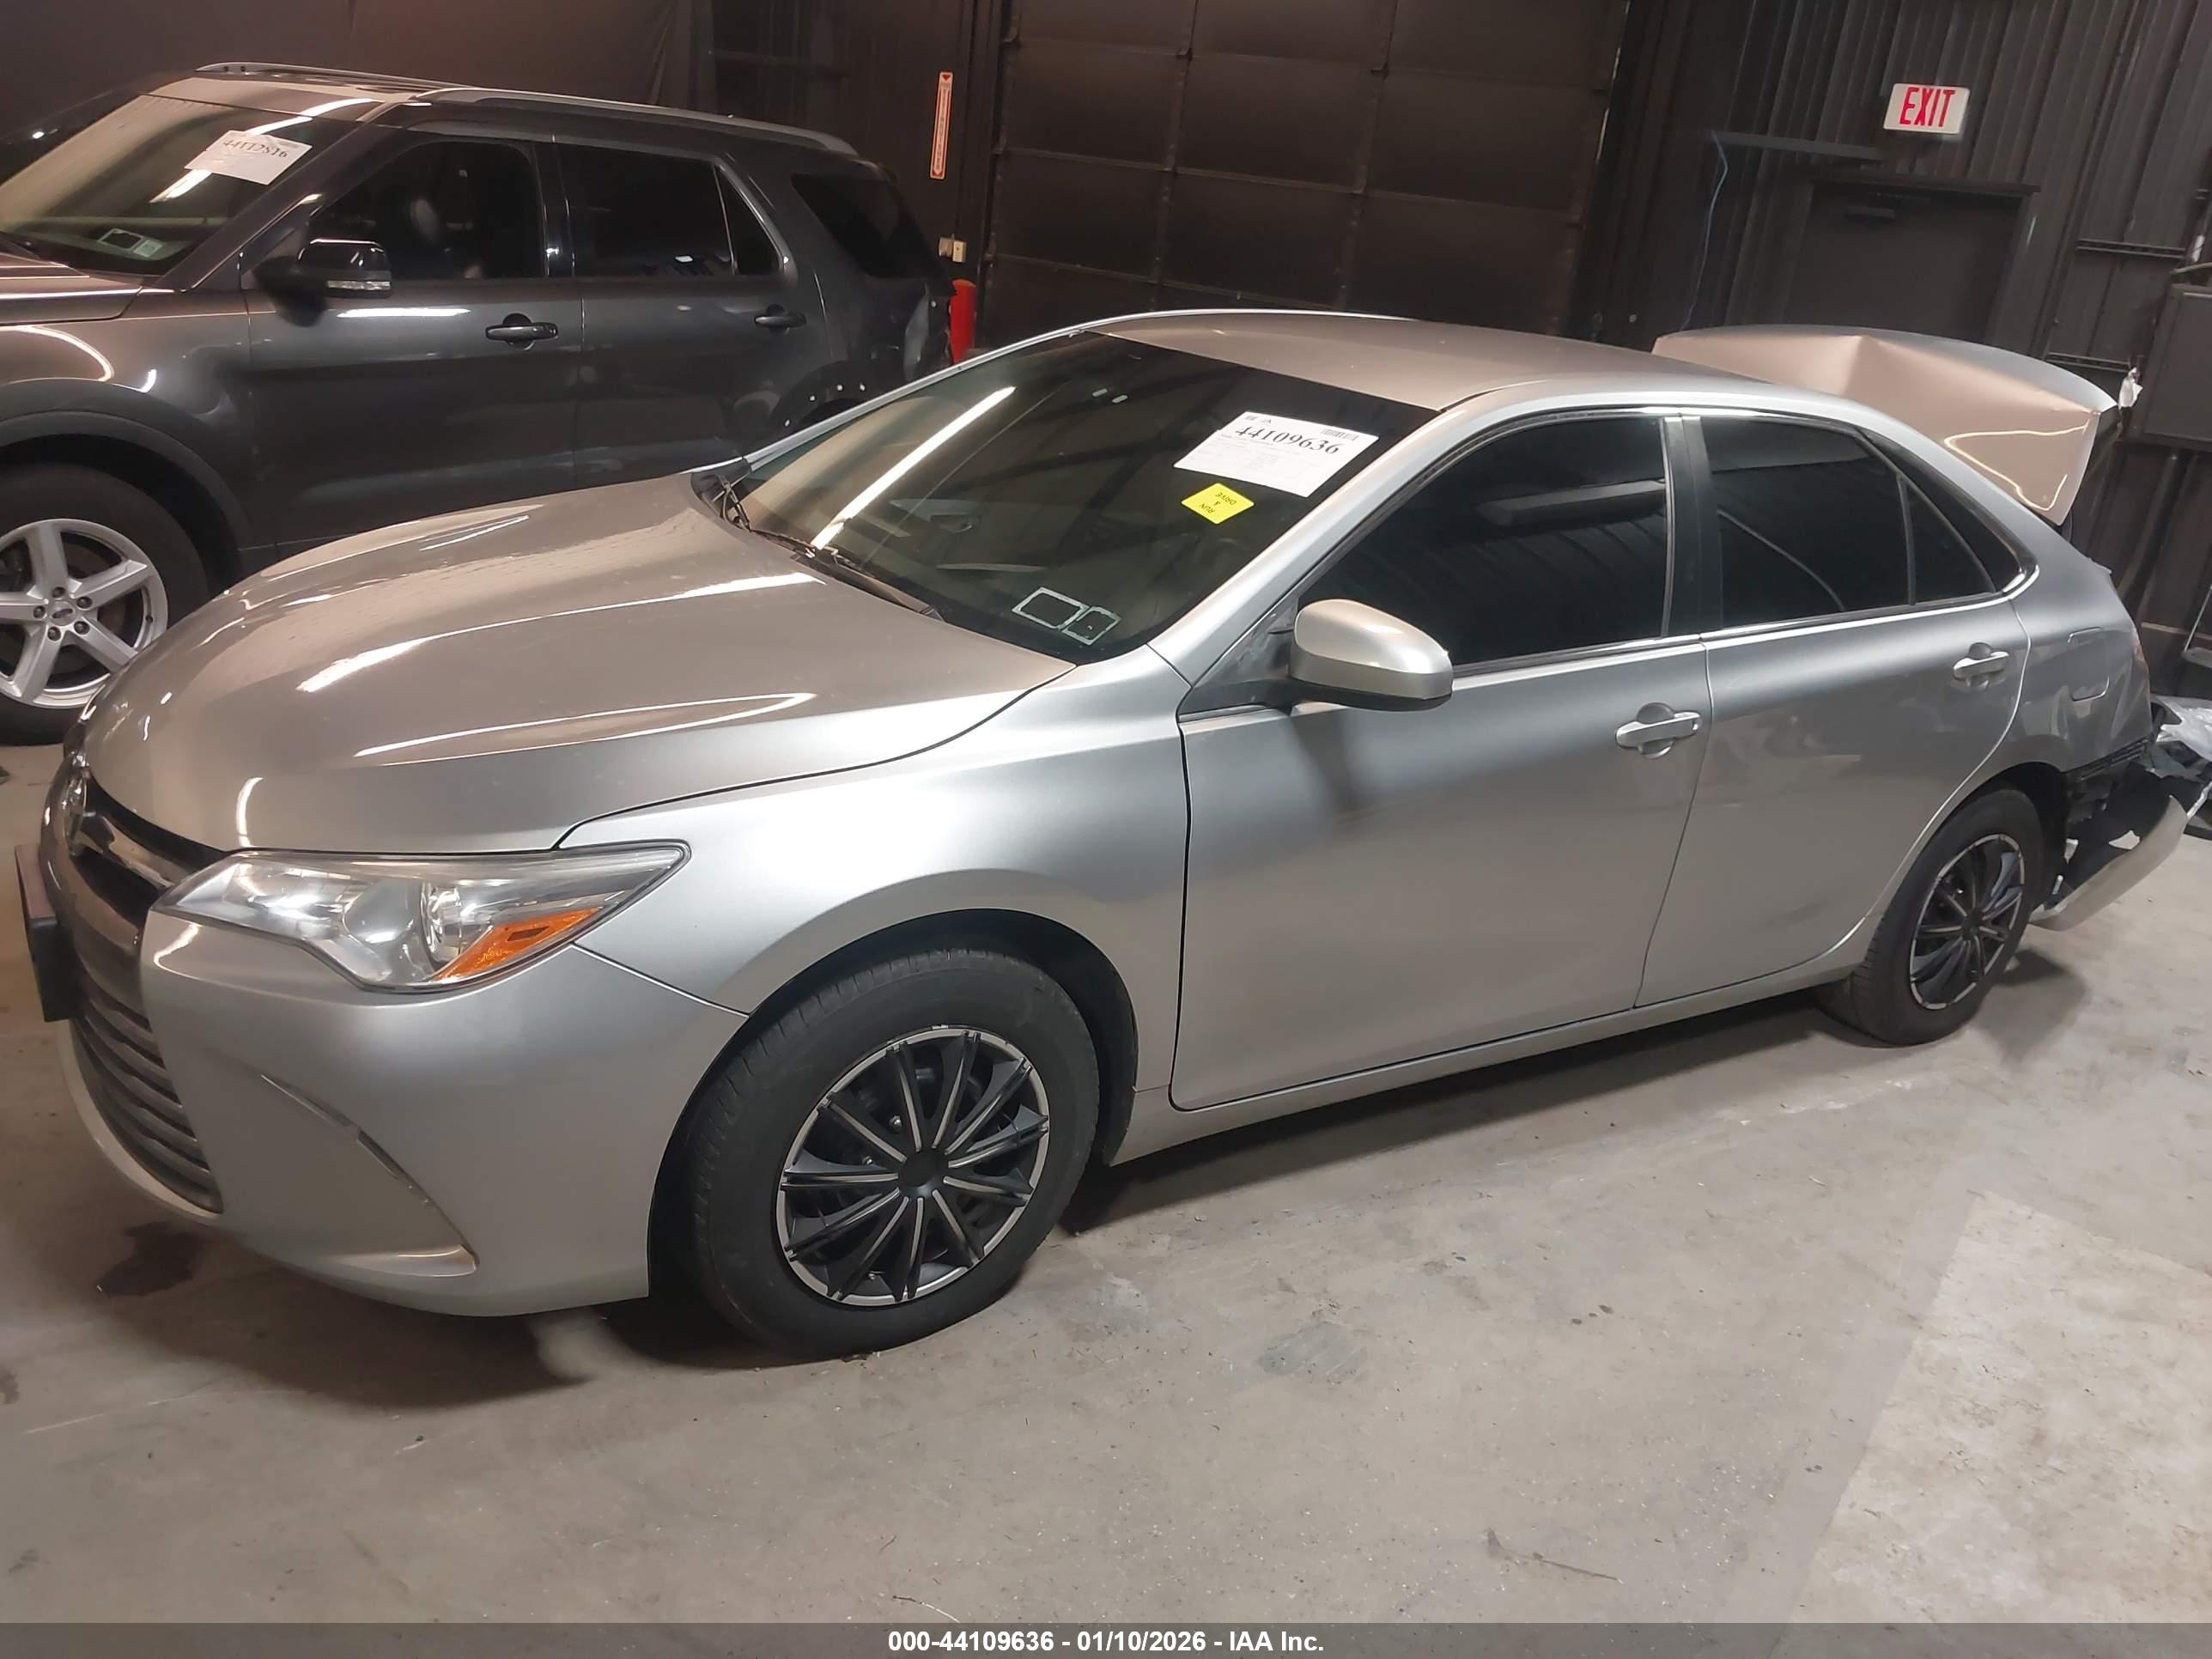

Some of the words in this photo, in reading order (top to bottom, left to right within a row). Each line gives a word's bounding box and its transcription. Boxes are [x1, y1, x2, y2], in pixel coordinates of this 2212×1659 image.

[1899, 87, 1955, 127] EXIT
[1235, 426, 1345, 455] 44109636
[1199, 503, 1216, 514] RUN
[1215, 492, 1237, 506] DRIVE
